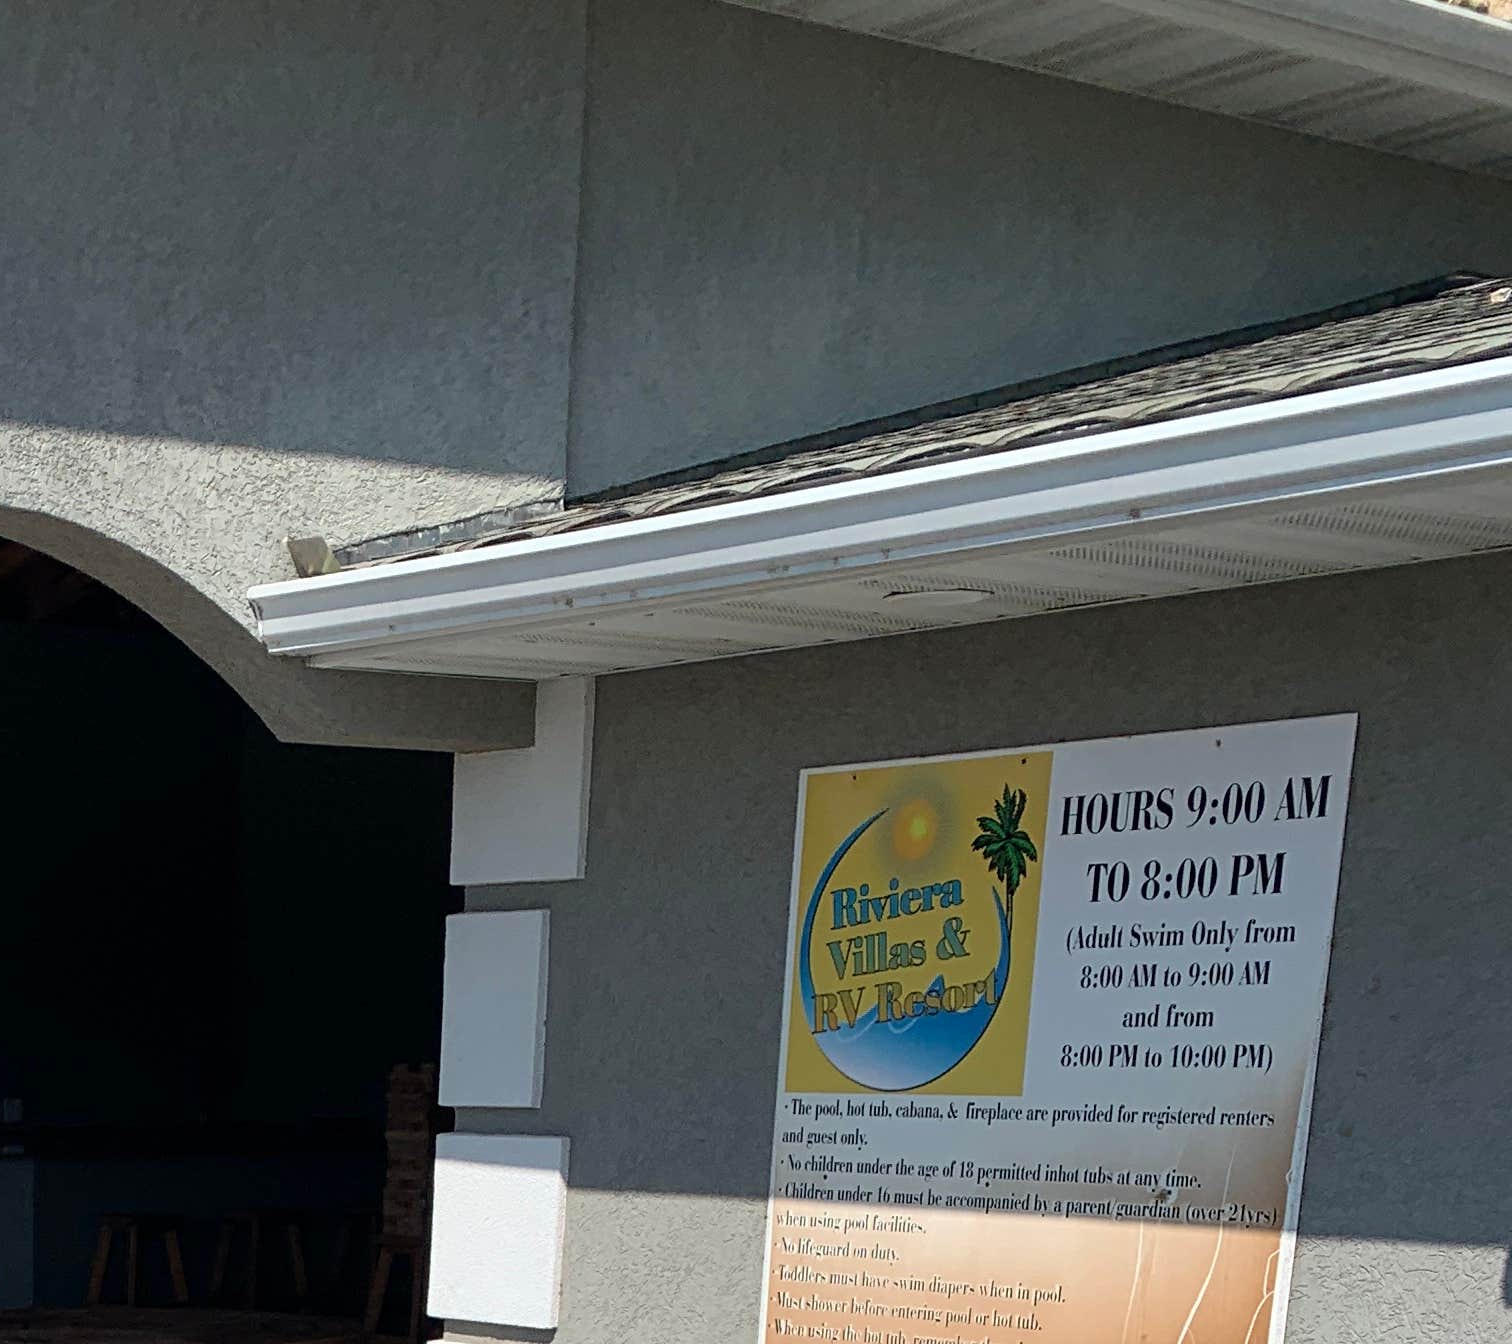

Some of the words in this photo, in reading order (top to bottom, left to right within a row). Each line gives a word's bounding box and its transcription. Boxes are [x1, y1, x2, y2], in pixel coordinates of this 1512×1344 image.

[1060, 787, 1175, 836] HOURS
[1186, 780, 1266, 828] 9:00
[1274, 774, 1333, 821] AM
[1087, 861, 1130, 903] TO
[1141, 856, 1217, 901] 8:00
[1228, 852, 1287, 896] PM
[830, 878, 965, 930] Riviera
[826, 931, 927, 980] Villas
[936, 916, 970, 960] &
[1066, 925, 1123, 955] (Adult
[1129, 923, 1184, 948] Swim
[1191, 920, 1239, 952] Only
[1244, 918, 1296, 944] from
[1080, 964, 1123, 989] 8:00
[1128, 963, 1157, 988] AM
[1163, 965, 1182, 987] to
[1188, 961, 1234, 987] 9:00
[1239, 960, 1271, 985] AM
[811, 986, 866, 1035] RV
[875, 967, 998, 1024] Resort
[1122, 1004, 1160, 1028] and
[1165, 1004, 1214, 1028] from
[1060, 1044, 1102, 1068] 8:00
[1108, 1044, 1138, 1068] PM
[1144, 1046, 1163, 1068] to
[1170, 1044, 1226, 1069] 10:00
[1232, 1044, 1273, 1075] PM)
[790, 1098, 812, 1116] The
[814, 1099, 843, 1121] pool,
[846, 1100, 865, 1117] hot
[946, 1102, 959, 1119] &
[964, 1101, 1023, 1126] fireplace
[1025, 1107, 1049, 1121] are
[1051, 1103, 1114, 1127] provided
[1116, 1104, 1139, 1123] for
[1140, 1104, 1216, 1130] registered
[1219, 1108, 1275, 1126] renters
[781, 1125, 803, 1143] and
[805, 1130, 837, 1148] guest
[839, 1127, 868, 1151] only.
[786, 1154, 801, 1171] No
[803, 1154, 854, 1173] children
[856, 1156, 893, 1175] under
[894, 1157, 915, 1176] the
[916, 1163, 939, 1181] age
[941, 1159, 957, 1177] of
[958, 1159, 974, 1178] 18
[976, 1161, 1041, 1185] permitted
[1082, 1164, 1114, 1184] tubs
[1116, 1169, 1131, 1185] at
[1133, 1172, 1161, 1192] any
[1164, 1168, 1202, 1188] time.
[784, 1180, 834, 1200] Children
[836, 1183, 873, 1202] under
[876, 1185, 891, 1203] 16
[893, 1190, 924, 1205] must
[926, 1187, 943, 1206] be
[944, 1191, 1031, 1214] accompanied
[1032, 1192, 1047, 1217] by
[1052, 1199, 1062, 1213] a
[1064, 1199, 1181, 1224] parent/guardian
[1184, 1202, 1225, 1222] (over
[775, 1208, 806, 1227] when
[808, 1211, 841, 1230] using
[843, 1213, 869, 1235] pool
[871, 1214, 927, 1235] facilities.
[780, 1236, 794, 1253] No
[796, 1237, 850, 1258] lifeguard
[852, 1246, 867, 1259] on
[869, 1242, 900, 1267] duty.
[777, 1263, 826, 1284] Toddlers
[829, 1272, 858, 1286] must
[861, 1270, 890, 1289] have
[892, 1273, 925, 1292] swim
[927, 1275, 975, 1299] diapers
[978, 1279, 1014, 1299] when
[1017, 1282, 1030, 1300] in
[1033, 1284, 1066, 1306] pool.
[775, 1290, 802, 1310] Must
[804, 1293, 848, 1313] shower
[850, 1297, 888, 1317] before
[890, 1303, 942, 1323] entering
[944, 1306, 972, 1328] pool
[974, 1313, 990, 1326] or
[991, 1309, 1013, 1328] hot
[1016, 1311, 1042, 1331] tub.
[773, 1318, 804, 1337] When
[807, 1321, 839, 1342] using
[841, 1324, 857, 1343] the
[863, 1326, 882, 1344] hot
